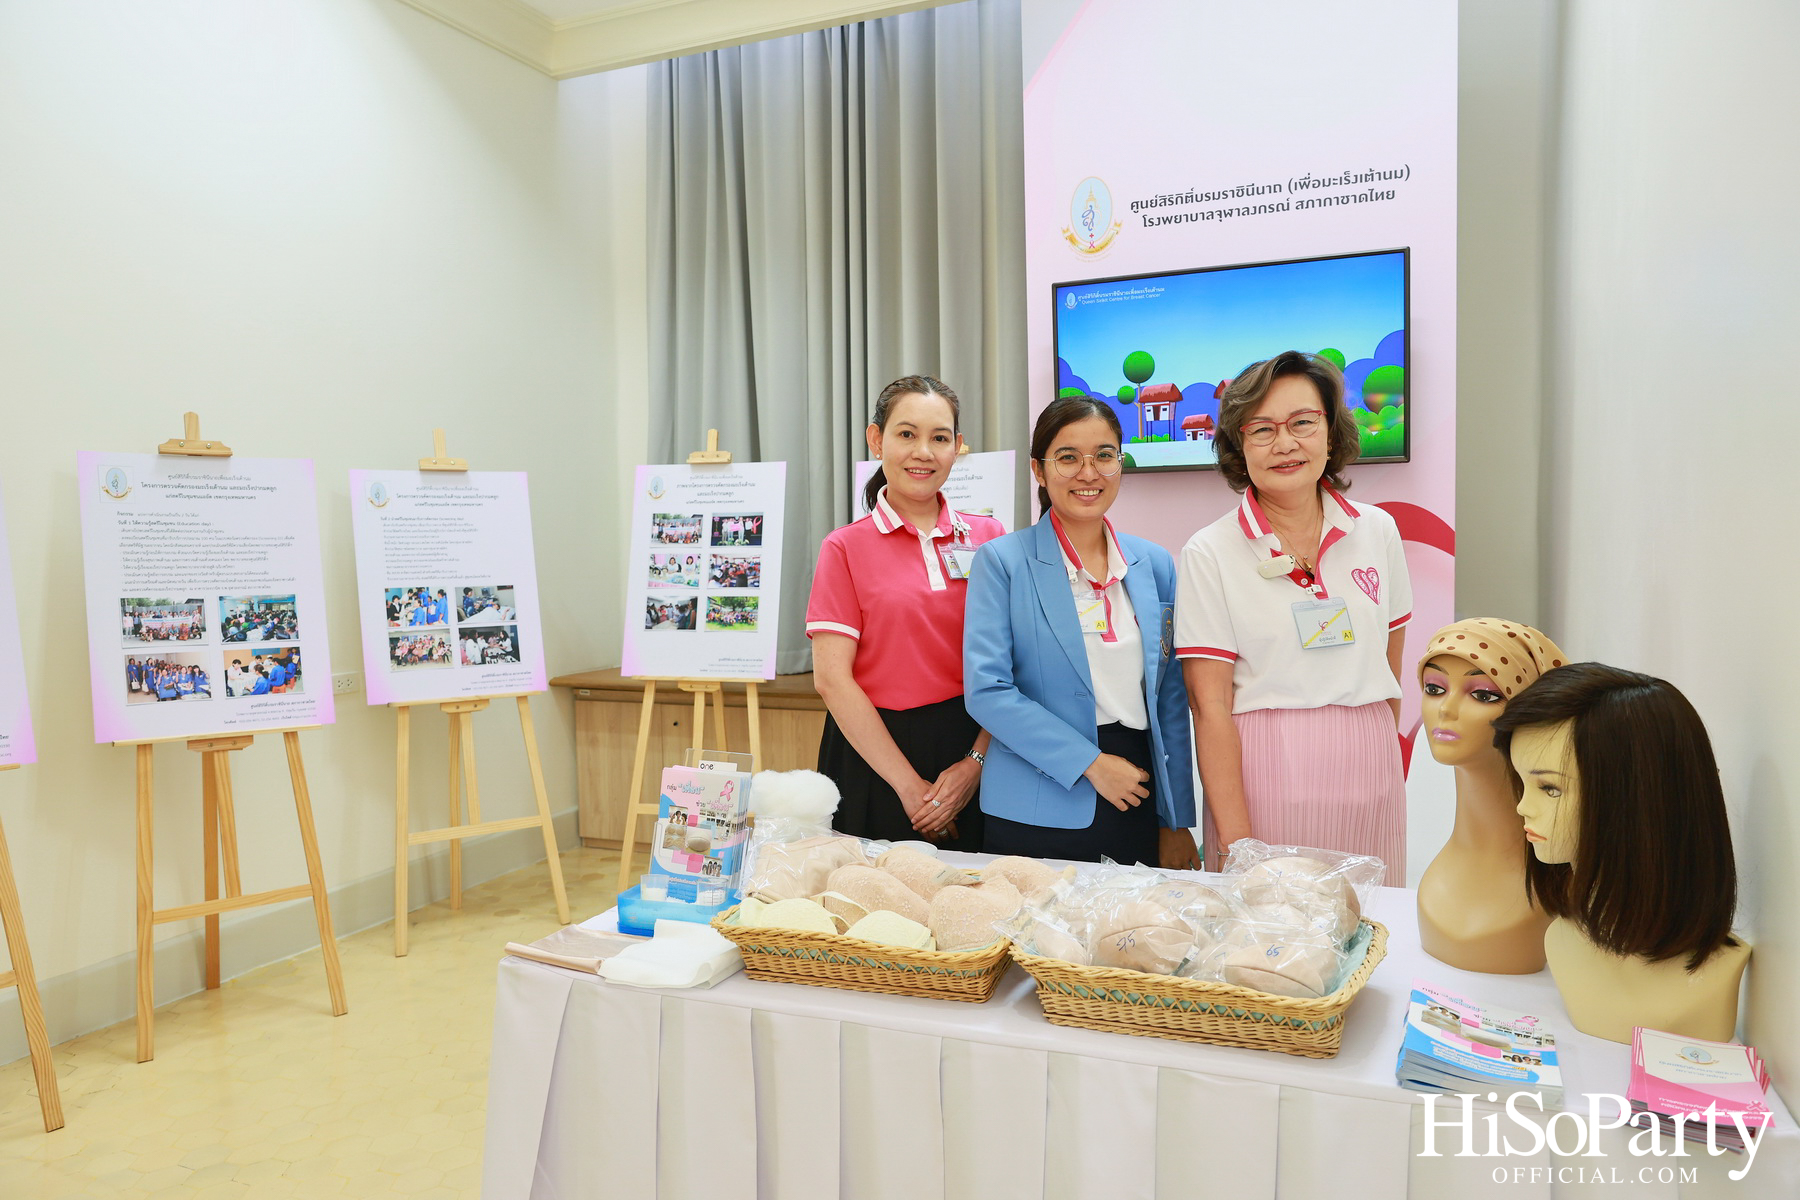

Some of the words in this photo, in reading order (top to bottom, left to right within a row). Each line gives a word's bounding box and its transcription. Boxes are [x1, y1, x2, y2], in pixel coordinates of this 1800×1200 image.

[1130, 183, 1282, 213] ศูนย์สิริกิติ์บรมราชินีนาถ
[1288, 164, 1410, 194] (เพื่อมะเร็งเต้านม)
[1142, 198, 1290, 228] โรงพยาบาลจุฬาลงกรณ์
[1295, 188, 1395, 211] สภากาชาดไทย
[1266, 944, 1286, 957] 65
